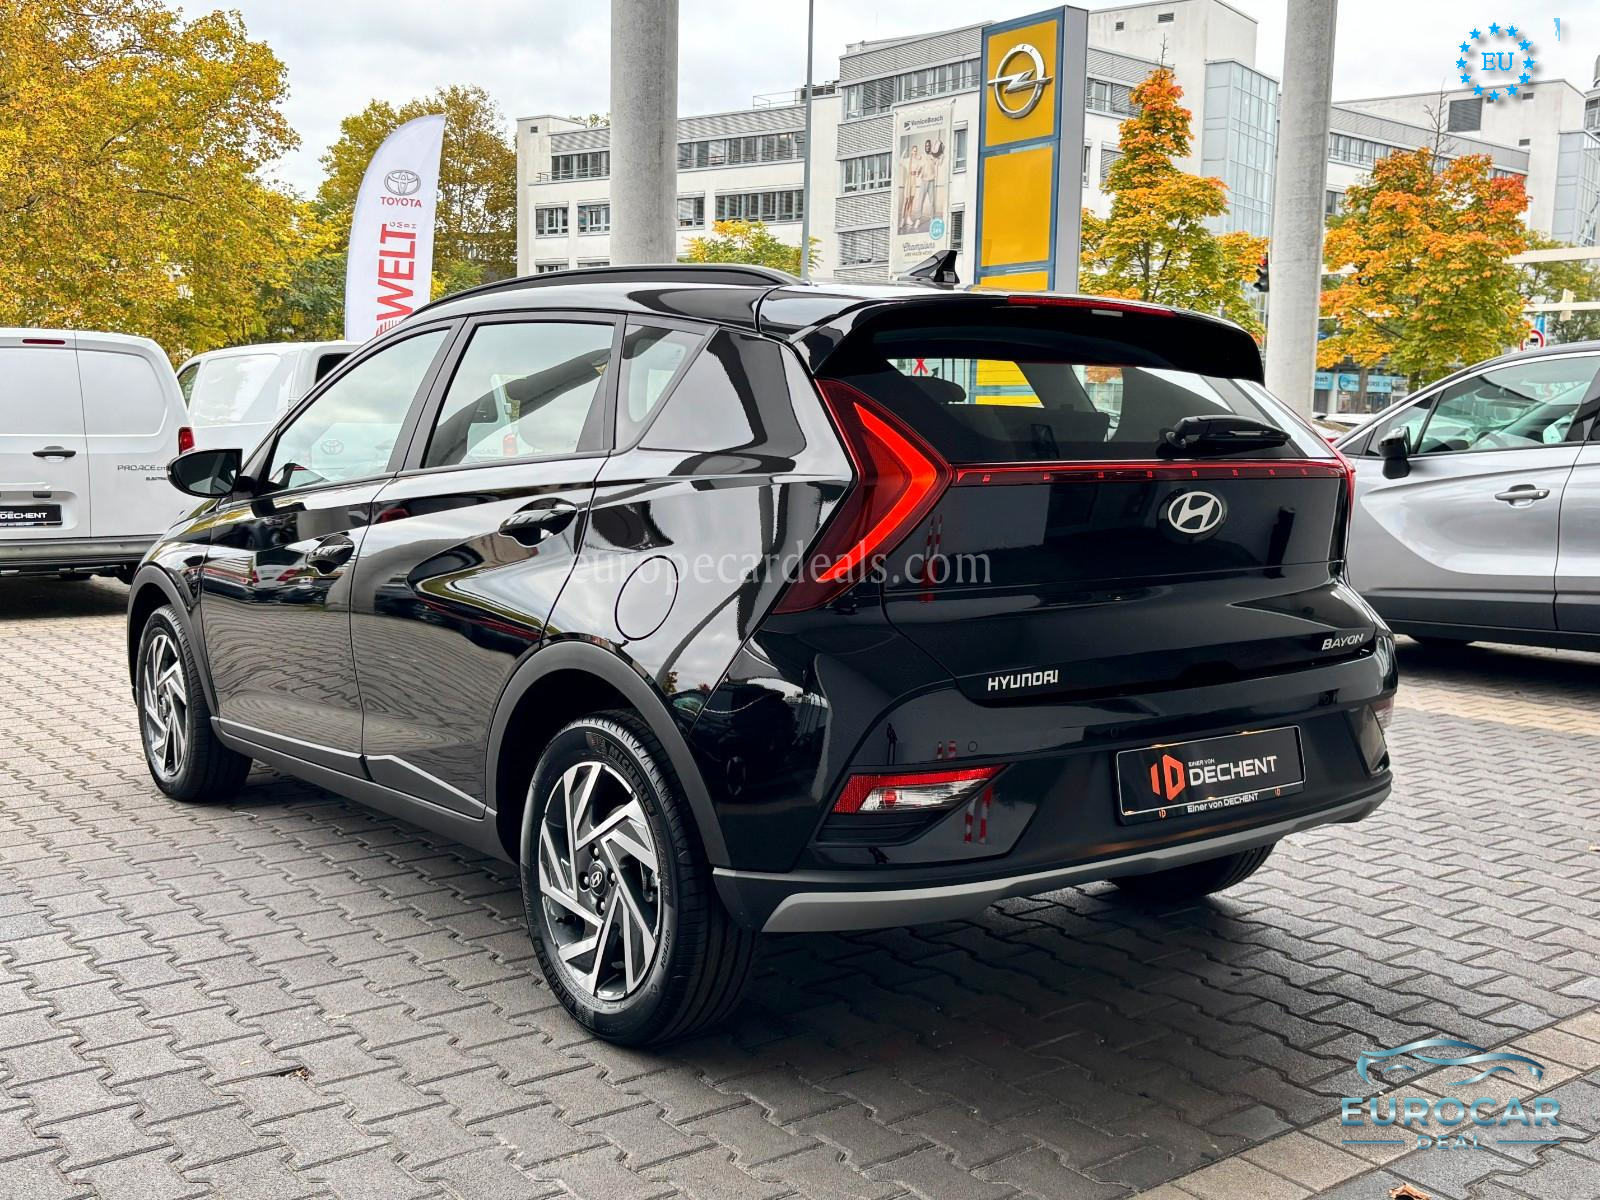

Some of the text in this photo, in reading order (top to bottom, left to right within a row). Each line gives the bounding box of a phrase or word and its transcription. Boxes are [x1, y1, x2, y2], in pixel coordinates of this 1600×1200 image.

[380, 196, 422, 208] TOYOTA
[376, 223, 416, 320] WELT
[0, 512, 47, 520] DECHENT
[1321, 633, 1364, 650] BAYON
[987, 669, 1059, 692] HYUNDAI
[1189, 755, 1278, 787] DECHENT
[1187, 792, 1259, 813] Einer von DECHENT
